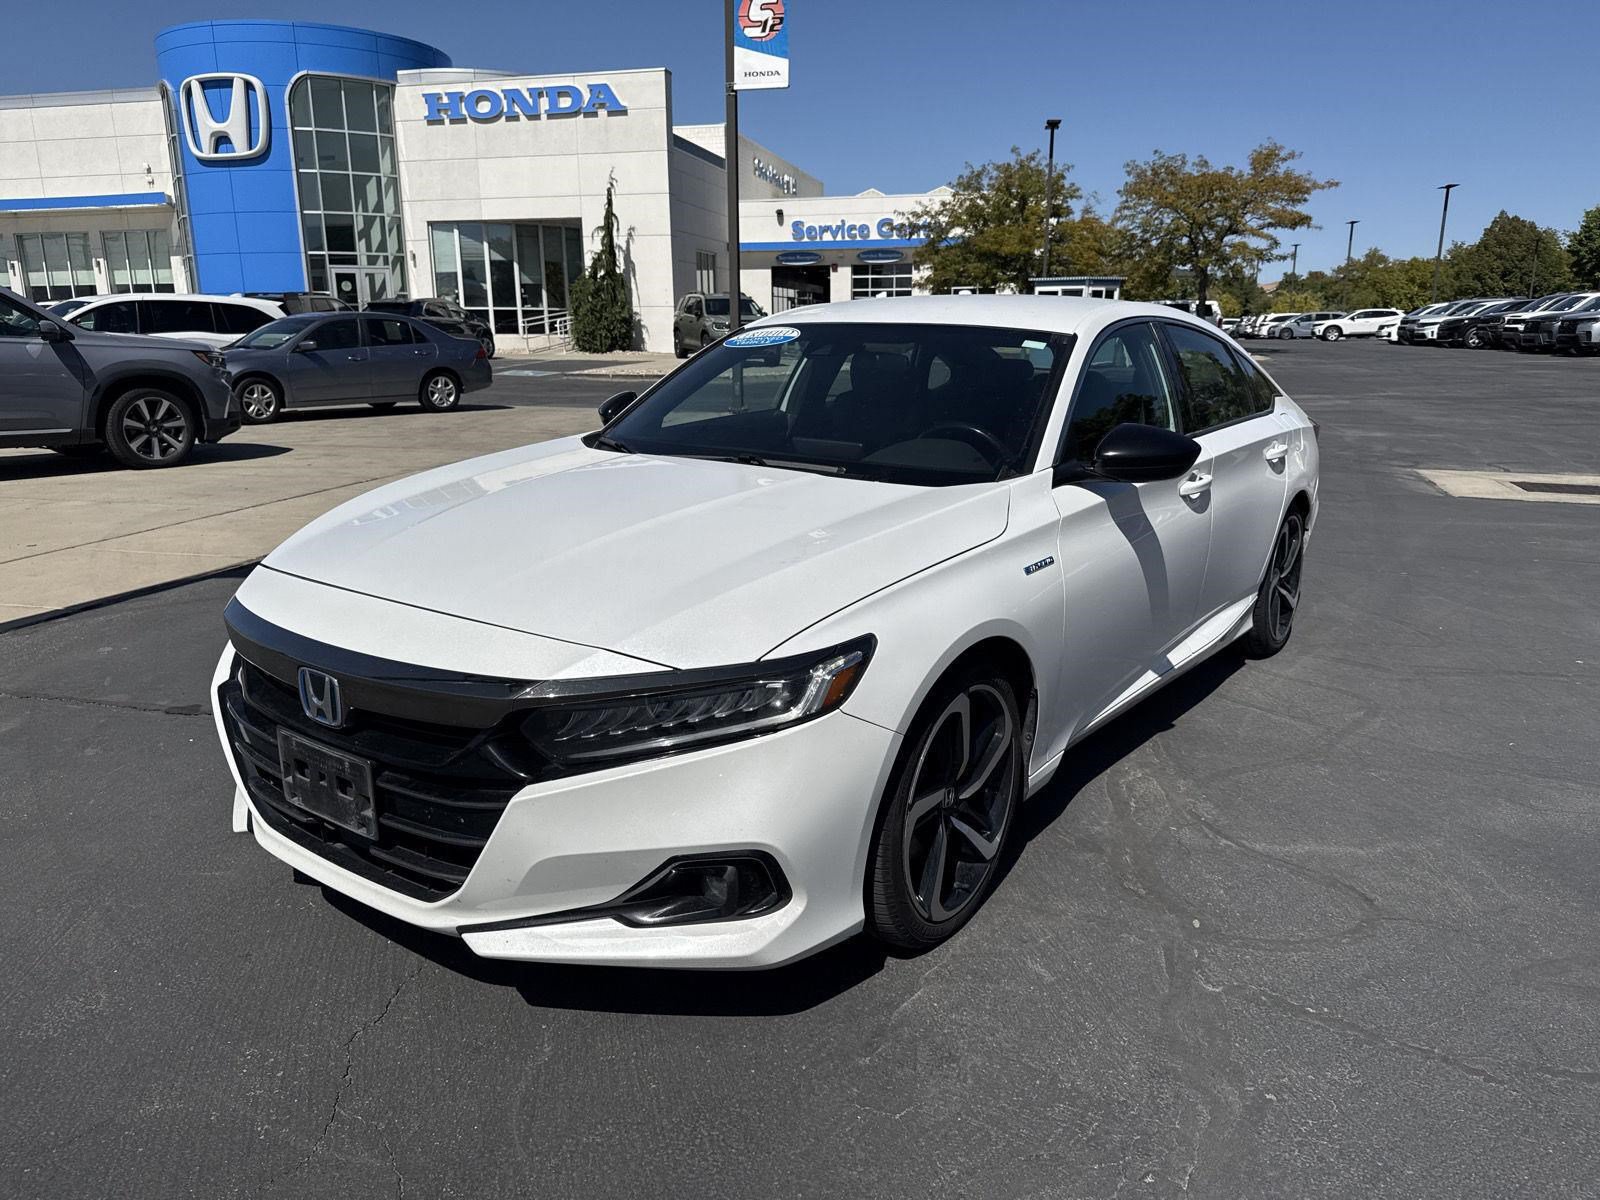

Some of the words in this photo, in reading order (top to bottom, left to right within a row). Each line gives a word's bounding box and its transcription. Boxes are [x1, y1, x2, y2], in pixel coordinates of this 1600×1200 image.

[744, 70, 781, 78] HONDA
[422, 83, 628, 126] HONDA
[791, 219, 870, 241] Service
